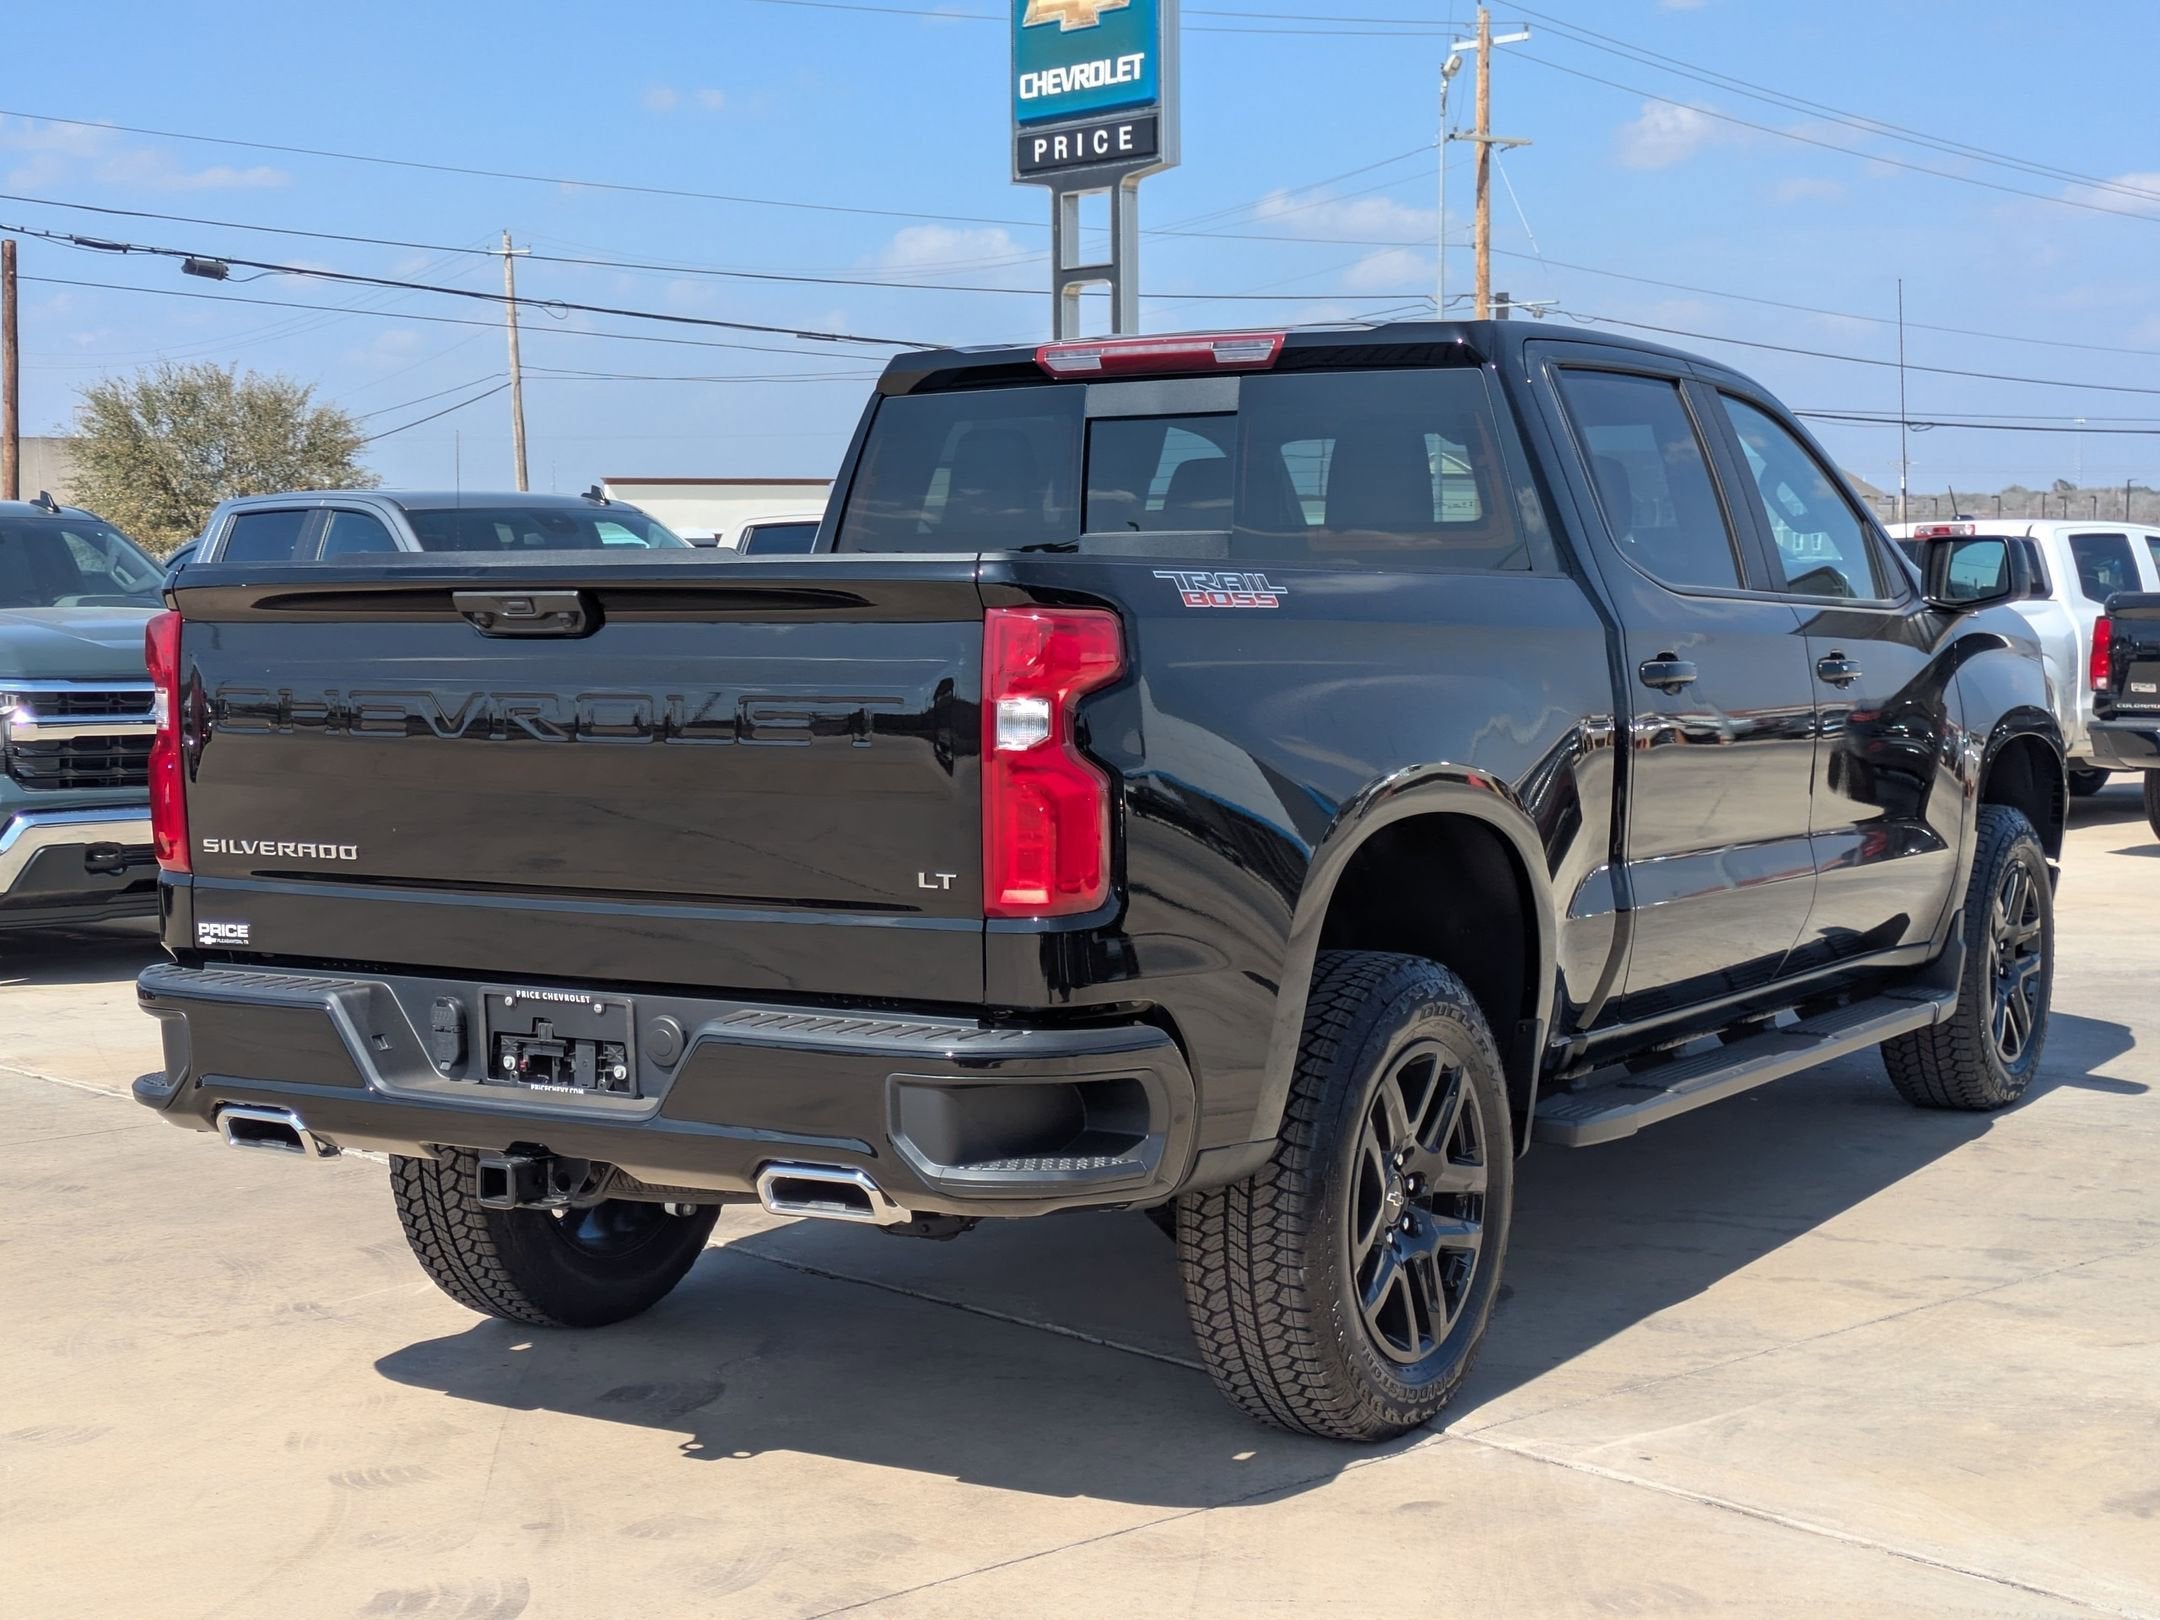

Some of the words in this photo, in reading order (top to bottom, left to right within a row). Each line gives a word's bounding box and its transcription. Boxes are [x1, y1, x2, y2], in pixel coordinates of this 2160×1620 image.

[1019, 53, 1145, 99] CHEVROLET
[1034, 125, 1133, 163] PRICE
[1153, 570, 1289, 594] TRAIL
[1180, 591, 1279, 608] BOSS
[215, 687, 905, 749] CHEVROLET
[203, 838, 358, 860] SILVERADO
[918, 872, 957, 890] LT
[198, 923, 249, 938] PRICE
[516, 990, 541, 1001] PRICE
[542, 992, 591, 1004] CHEVROLET
